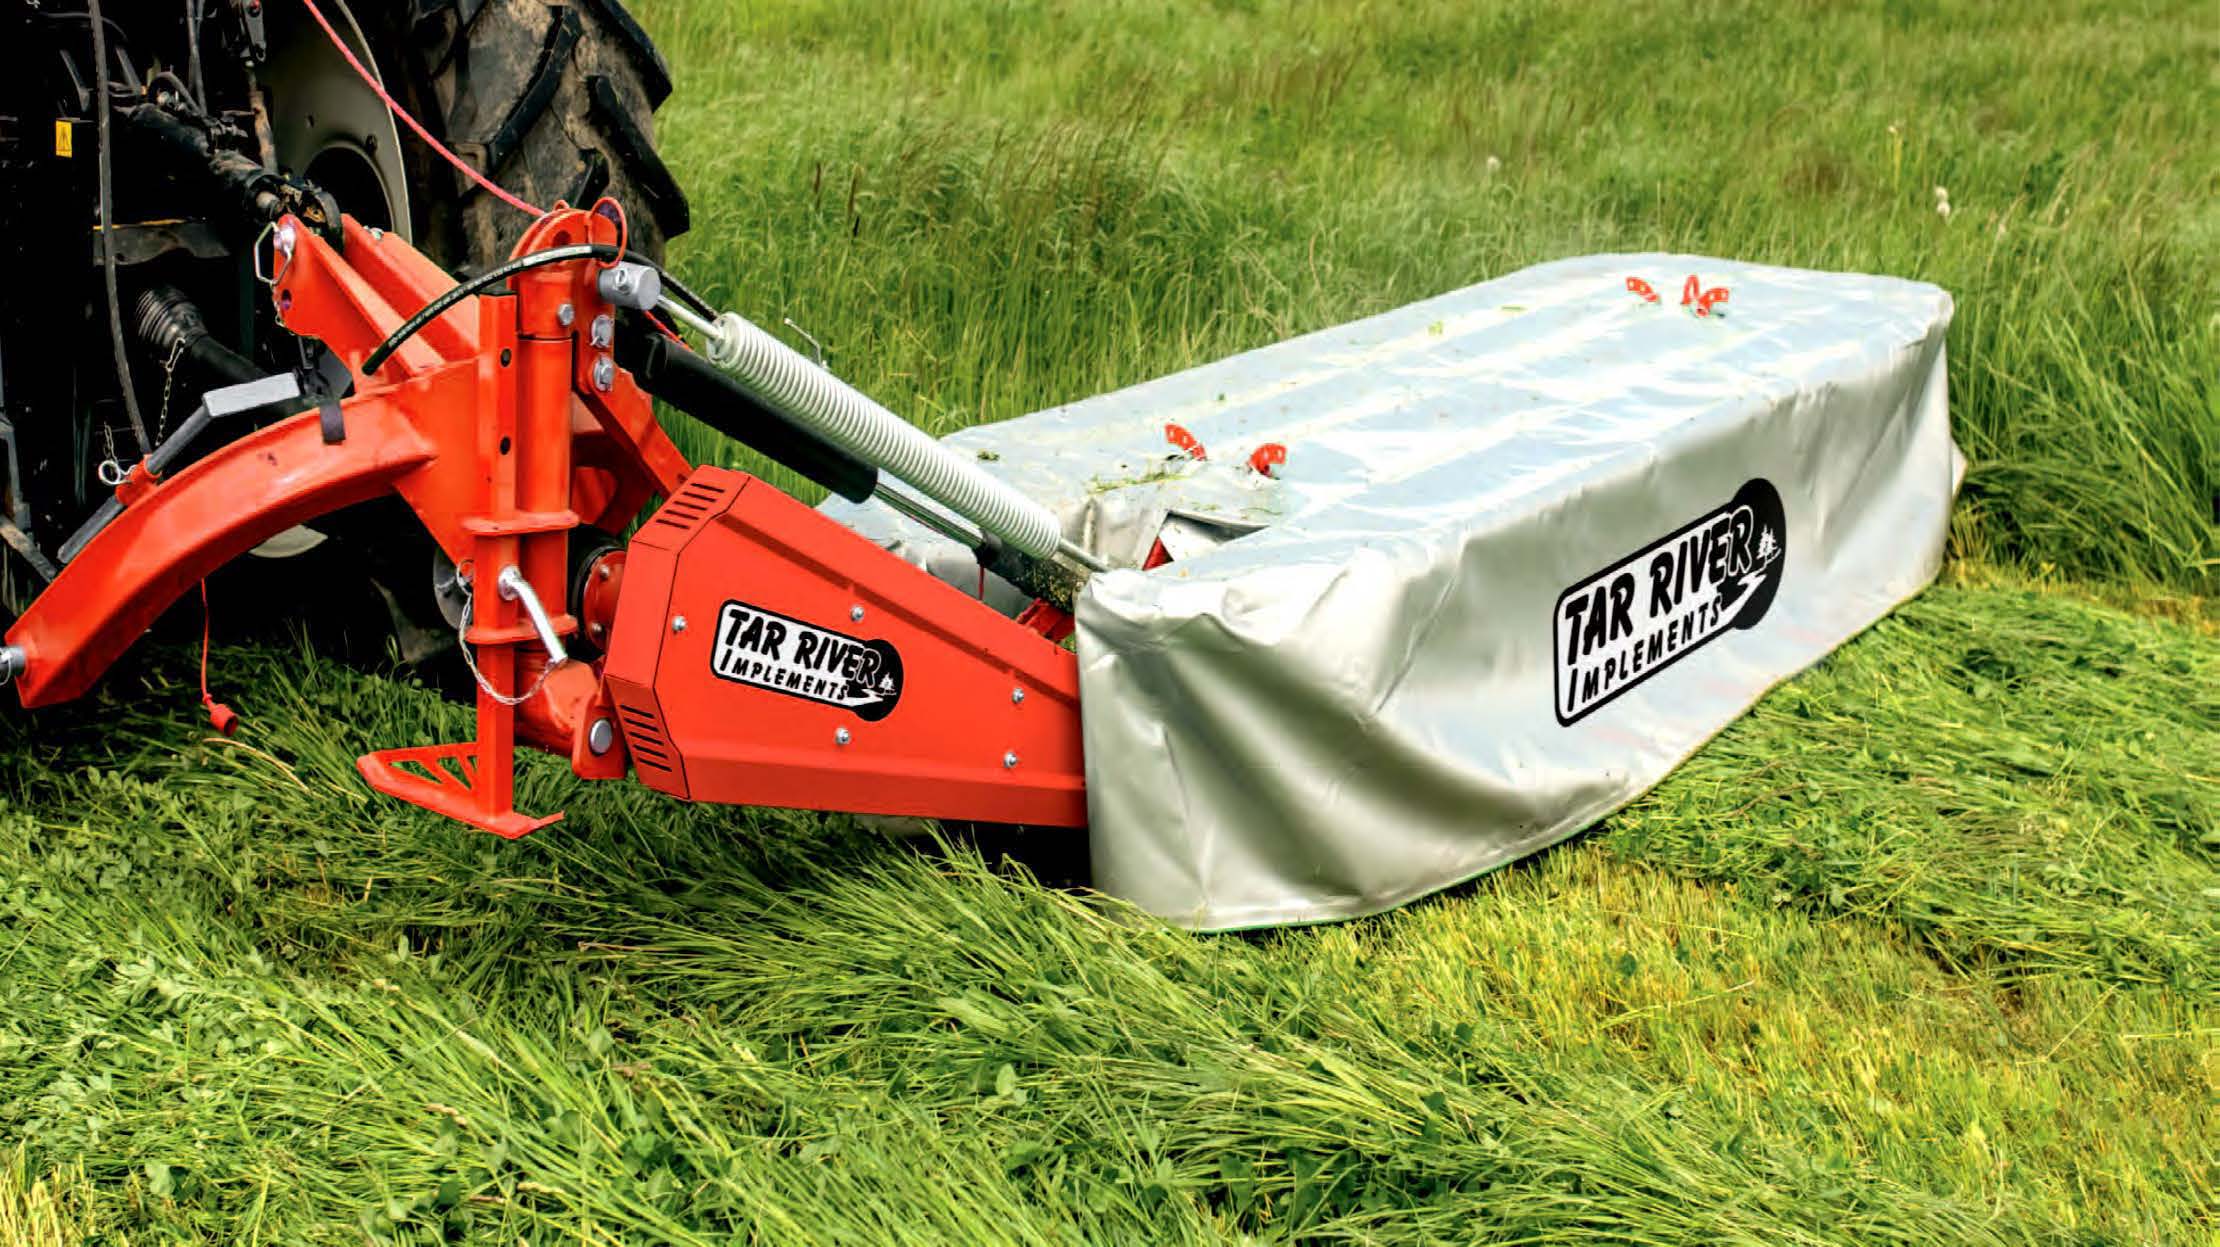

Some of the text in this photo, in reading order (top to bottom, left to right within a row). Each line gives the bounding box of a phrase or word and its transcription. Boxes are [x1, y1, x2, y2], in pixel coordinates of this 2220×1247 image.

[1565, 505, 1753, 665] TAR RIVER
[719, 648, 848, 700] IMPLEMENTS
[725, 608, 881, 688] TAR RIVER
[1567, 595, 1723, 712] IMPLEMENTS
